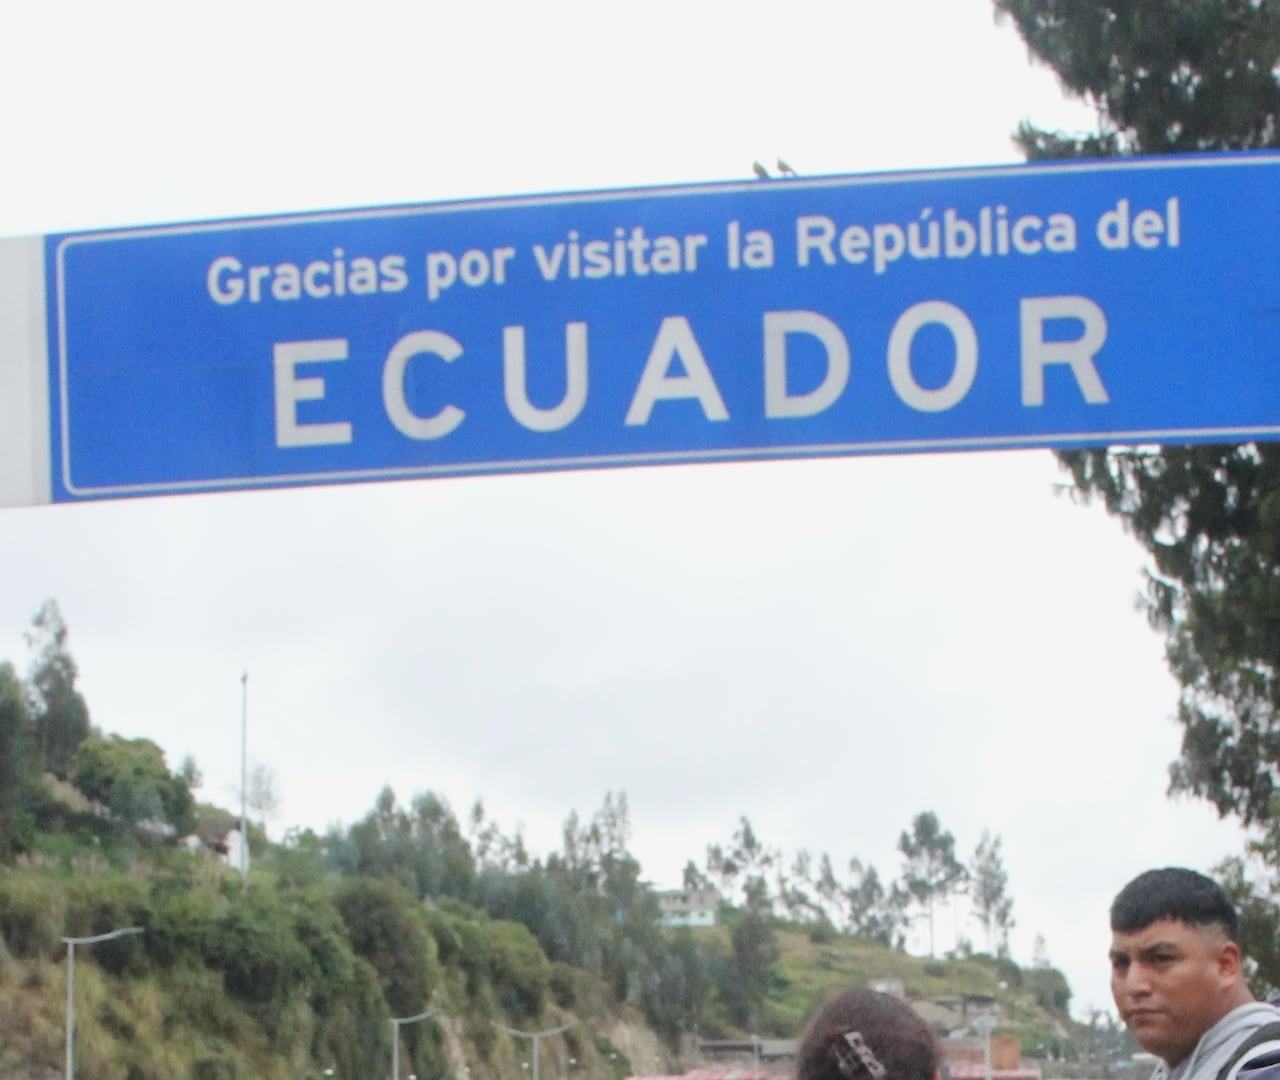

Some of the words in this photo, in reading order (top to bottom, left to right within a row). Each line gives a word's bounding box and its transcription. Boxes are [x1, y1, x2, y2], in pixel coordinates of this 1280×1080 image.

[206, 246, 410, 306] Gracias
[425, 246, 517, 301] por
[531, 226, 709, 281] visitar
[726, 219, 775, 270] la
[795, 203, 1078, 275] República
[1096, 197, 1181, 250] del
[272, 294, 1110, 449] ECUADOR
